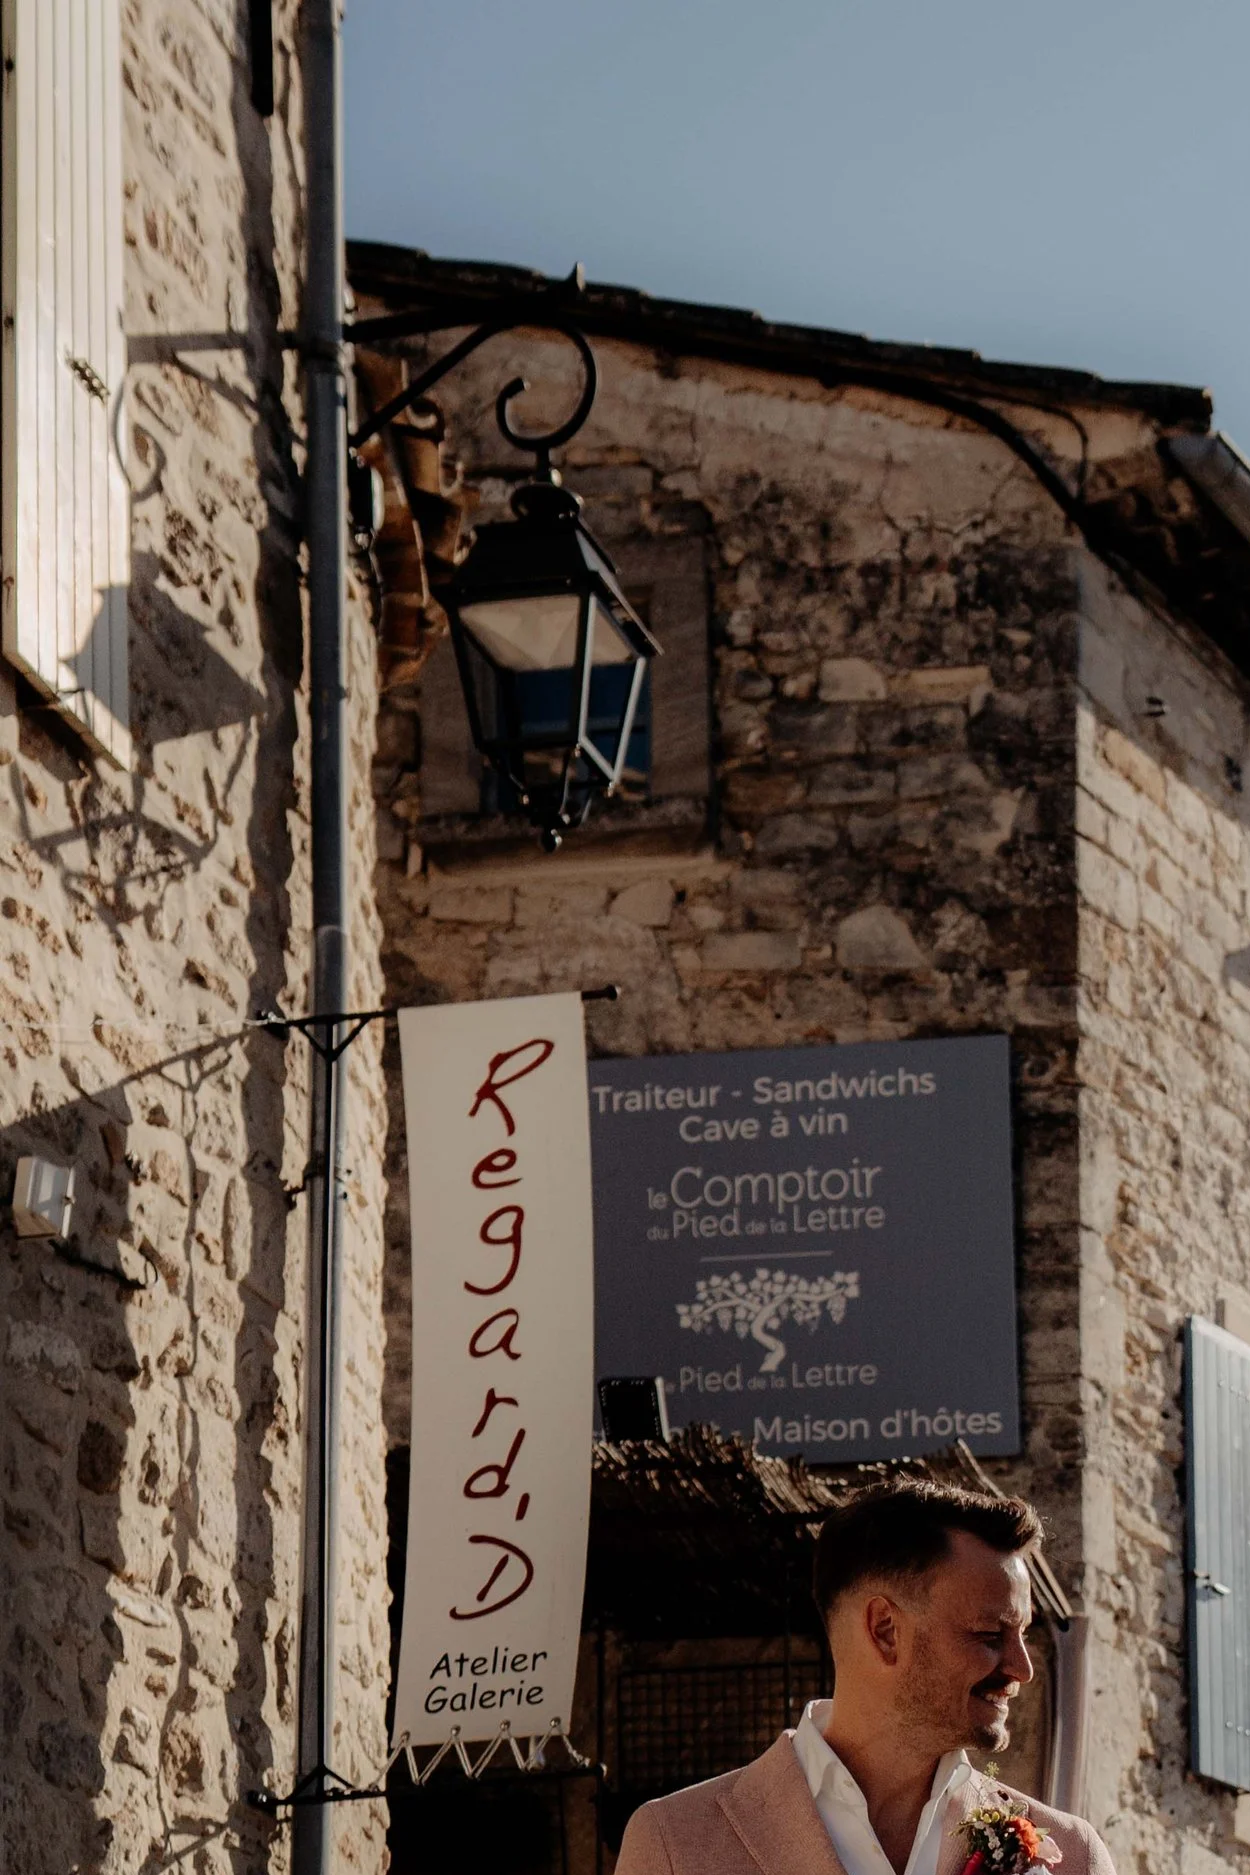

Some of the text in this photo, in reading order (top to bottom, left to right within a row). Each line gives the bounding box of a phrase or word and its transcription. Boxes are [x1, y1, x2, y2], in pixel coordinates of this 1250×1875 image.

[591, 1083, 722, 1114] Traiteur
[753, 1067, 937, 1105] Sandwichs
[679, 1107, 849, 1143] Cave à vin
[647, 1157, 882, 1214] le Comptoir
[646, 1203, 886, 1241] du Pied de la Lettre
[680, 1362, 742, 1394] Pied
[747, 1375, 767, 1391] de
[769, 1373, 787, 1389] la
[791, 1360, 878, 1389] Lettre
[754, 1413, 870, 1445] Maison
[880, 1406, 1003, 1437] d'hôtes
[430, 1644, 548, 1681] Atelier
[423, 1680, 545, 1715] Galerie
